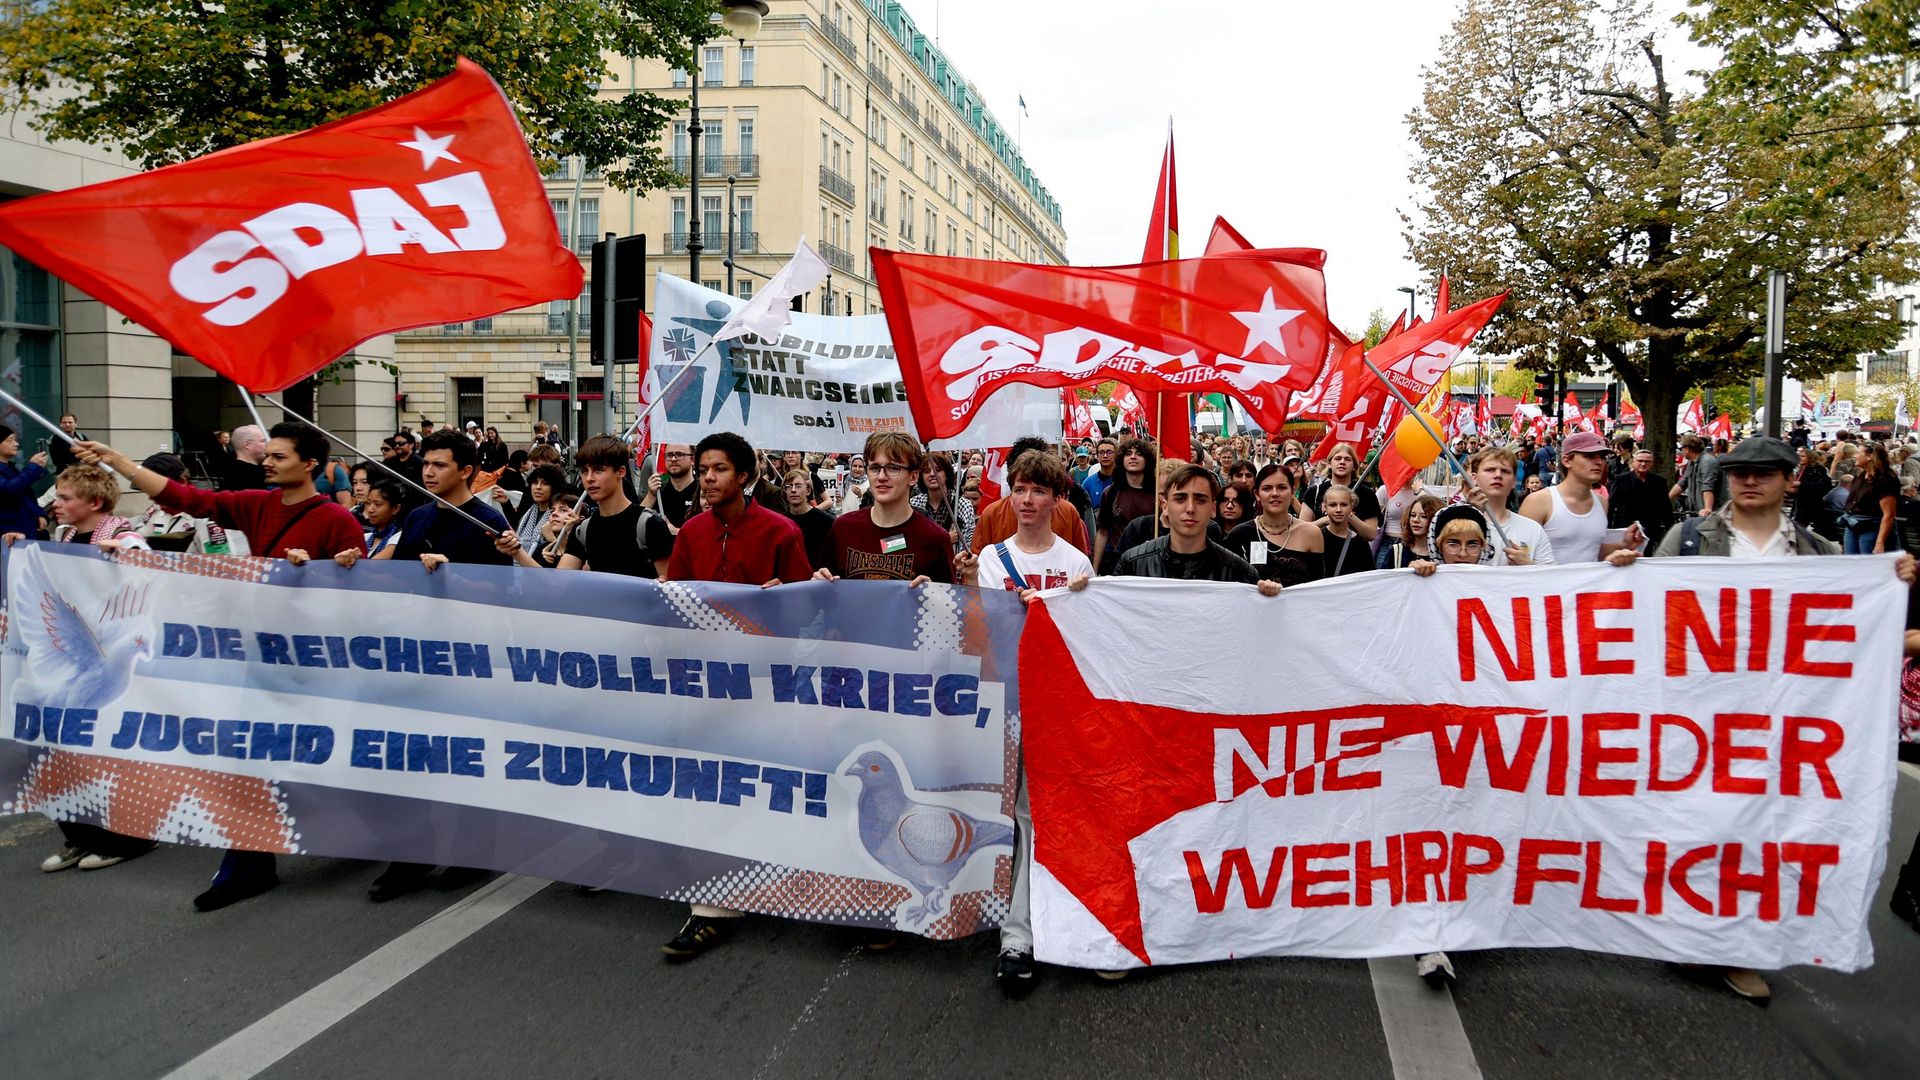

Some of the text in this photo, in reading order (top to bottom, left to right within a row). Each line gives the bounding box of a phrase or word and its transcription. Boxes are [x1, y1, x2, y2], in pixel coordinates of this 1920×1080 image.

[169, 171, 507, 326] SDAJ
[729, 347, 811, 375] STATT
[793, 415, 835, 428] SDAJ
[846, 547, 914, 579] LONSDALE
[162, 622, 992, 729] DIE REICHEN WOLLEN KRIEG,
[1456, 587, 1857, 682] NIE NIE
[13, 702, 829, 818] DIE JUGEND EINE ZUKUNFT!
[1213, 712, 1845, 803] NIE WIEDER
[1183, 829, 1840, 922] WEHRPFLICHT
